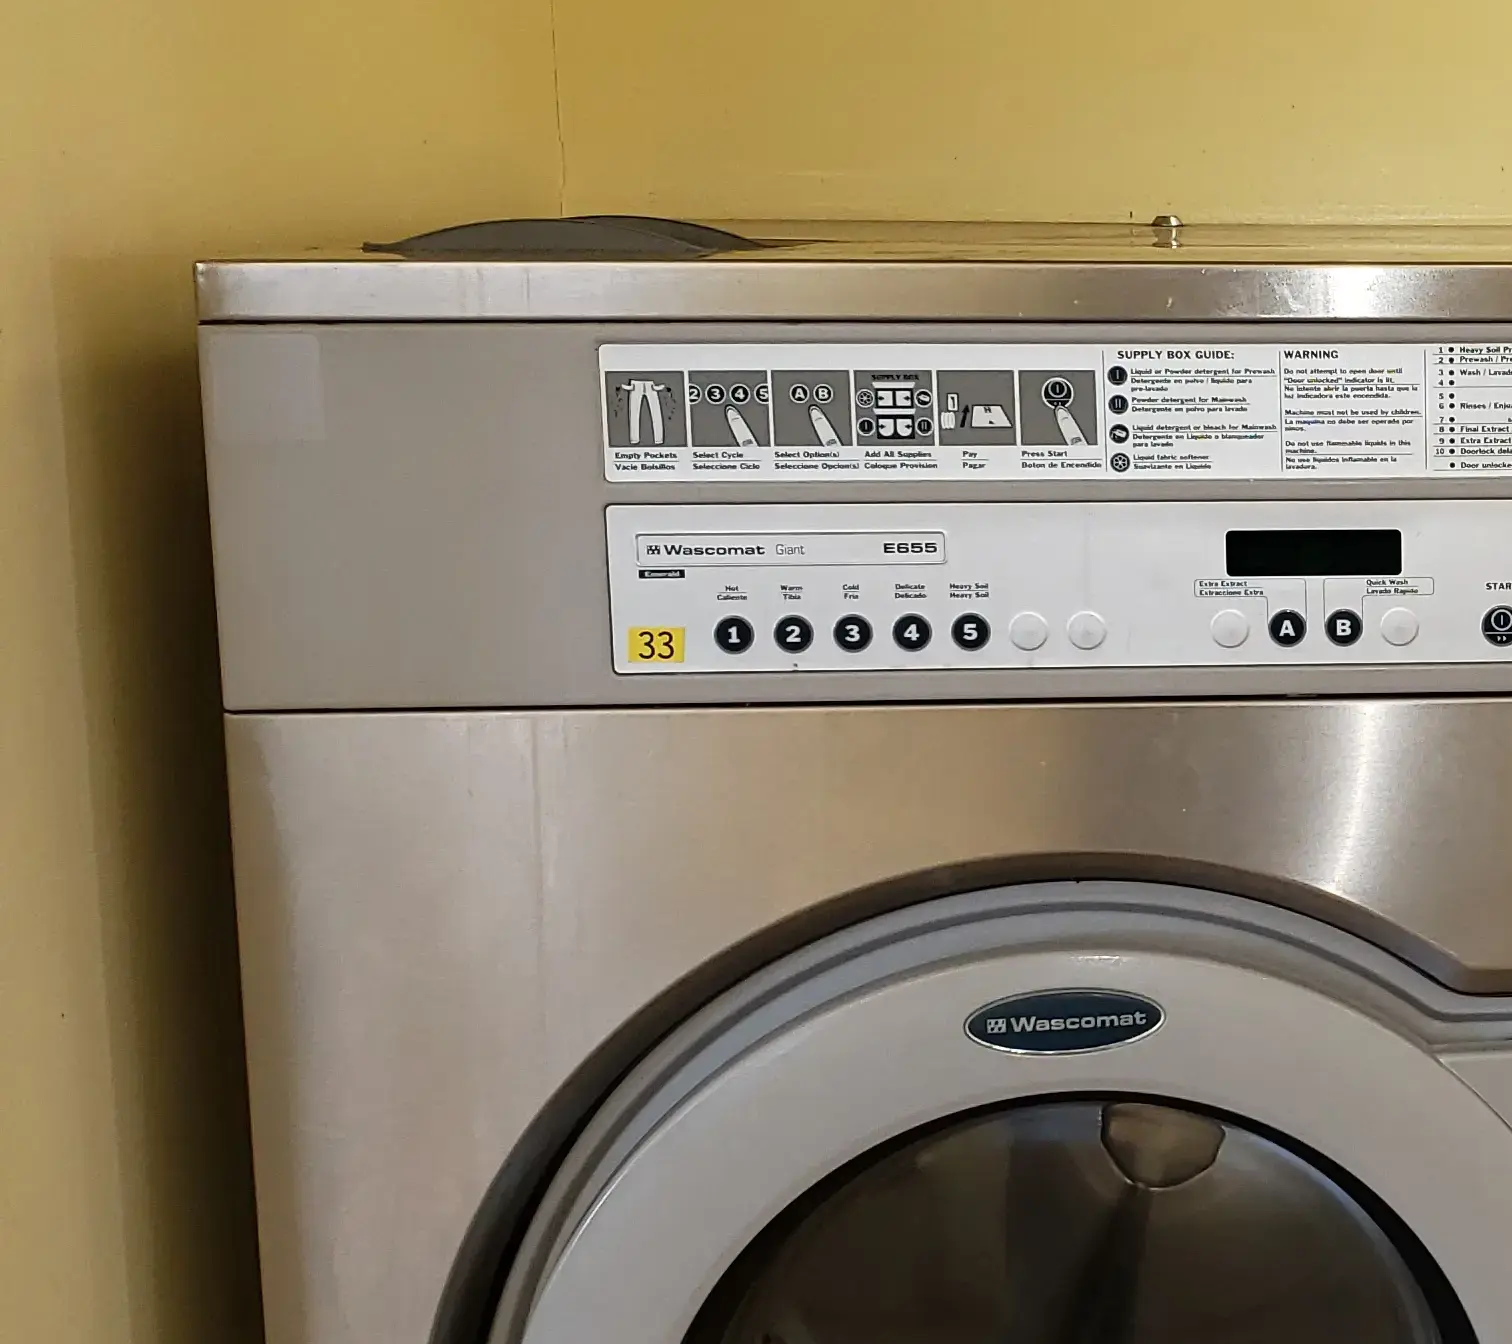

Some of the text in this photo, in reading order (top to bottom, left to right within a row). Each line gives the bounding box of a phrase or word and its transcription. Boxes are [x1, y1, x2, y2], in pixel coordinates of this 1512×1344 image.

[1117, 350, 1234, 359] SUPPLY BOX GUIDE:
[1283, 350, 1338, 358] WARNING
[663, 542, 937, 555] Wascomat Giant E655
[949, 582, 989, 590] Heavy Soil
[1366, 578, 1409, 587] Quick Wash
[728, 623, 977, 643] 1 2 3 4 5
[1279, 620, 1295, 637] A
[1336, 619, 1351, 635] B
[638, 631, 674, 659] 33
[1010, 1010, 1146, 1032] Wascomat
